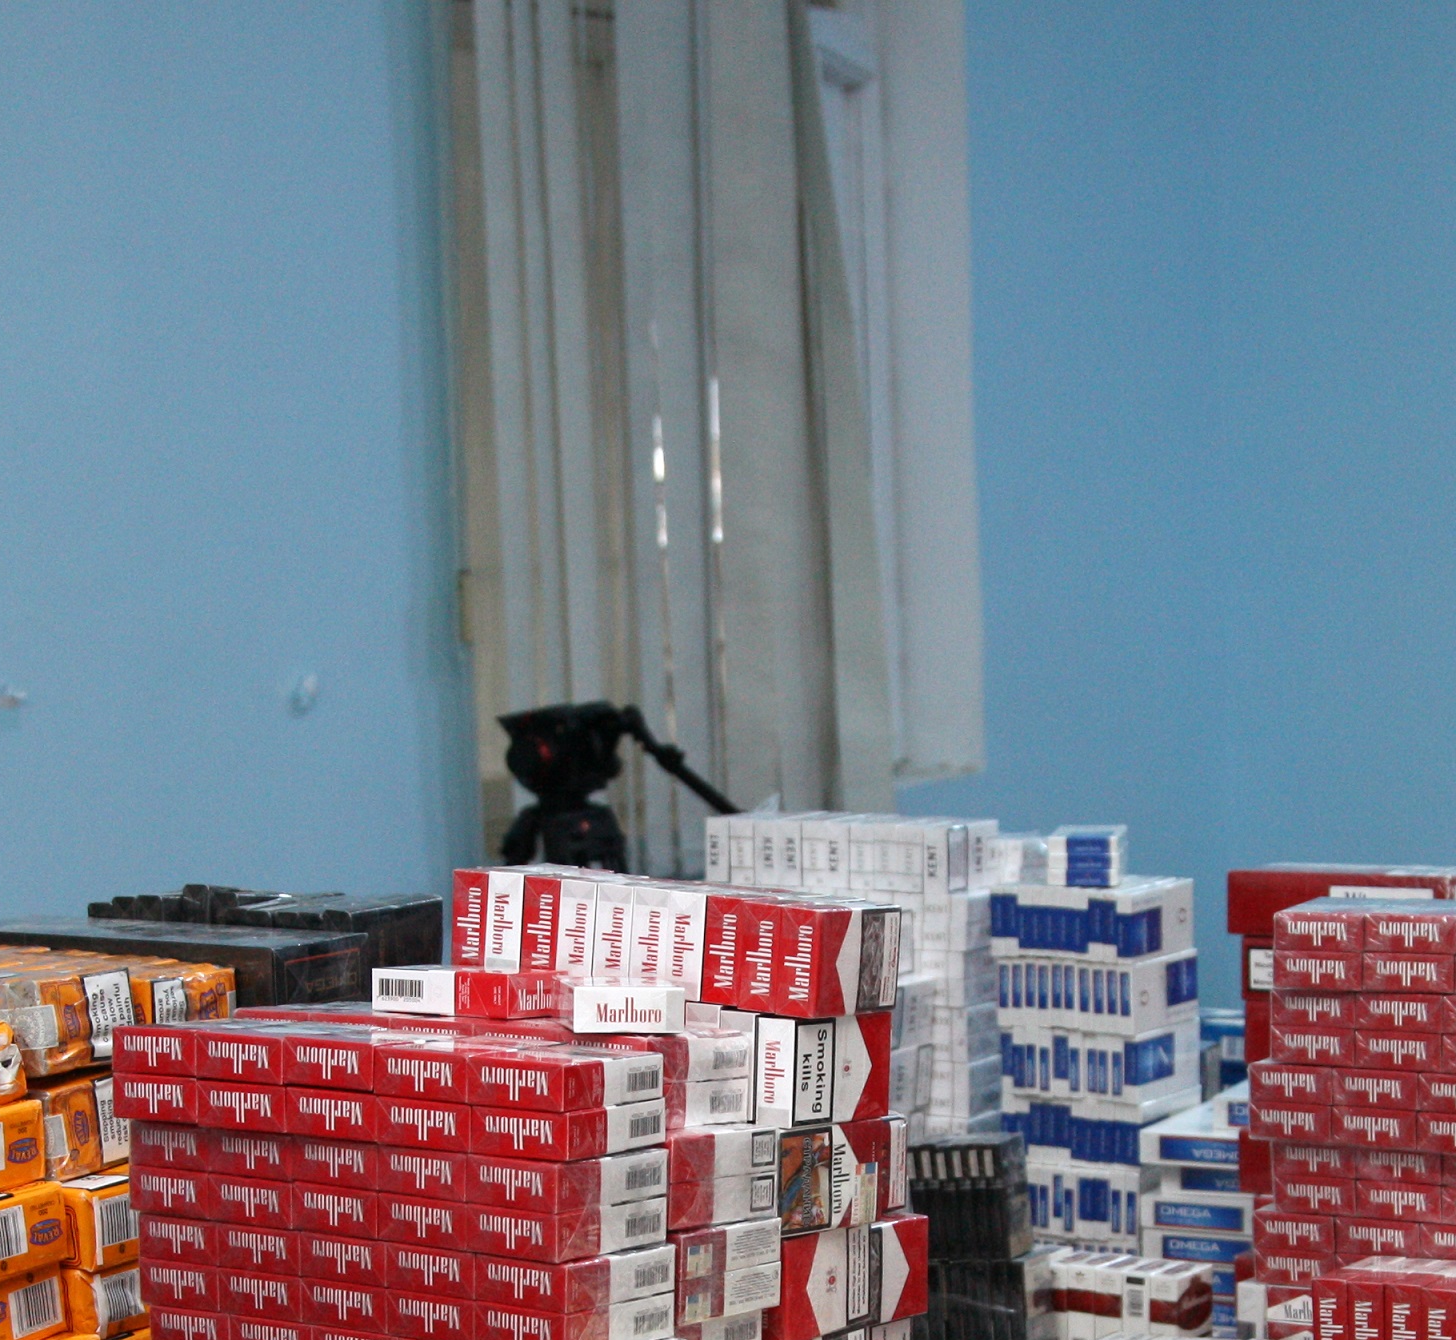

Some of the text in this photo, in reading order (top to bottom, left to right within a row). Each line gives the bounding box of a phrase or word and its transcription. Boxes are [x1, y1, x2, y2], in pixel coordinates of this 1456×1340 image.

[927, 845, 937, 878] KENT
[457, 886, 483, 960] Marlboro
[492, 892, 514, 955] Marlboro
[527, 893, 554, 968] Marlboro
[565, 902, 588, 966] Marlboro
[1288, 914, 1346, 946] Marlboro
[709, 913, 738, 990] Marlboro
[784, 925, 814, 1002] Marlboro
[596, 997, 662, 1024] Marlboro
[387, 1057, 453, 1092] Marlboro
[481, 1065, 548, 1101] Marlboro
[764, 1040, 786, 1104] Marlboro
[801, 1053, 813, 1092] kills
[811, 1029, 827, 1114] Smoking
[210, 1089, 272, 1123] Marlboro
[485, 1115, 553, 1150] Marlboro
[221, 1183, 279, 1218] Marlboro
[1160, 1206, 1211, 1218] OMEGA
[1169, 1240, 1220, 1252] OMEGA
